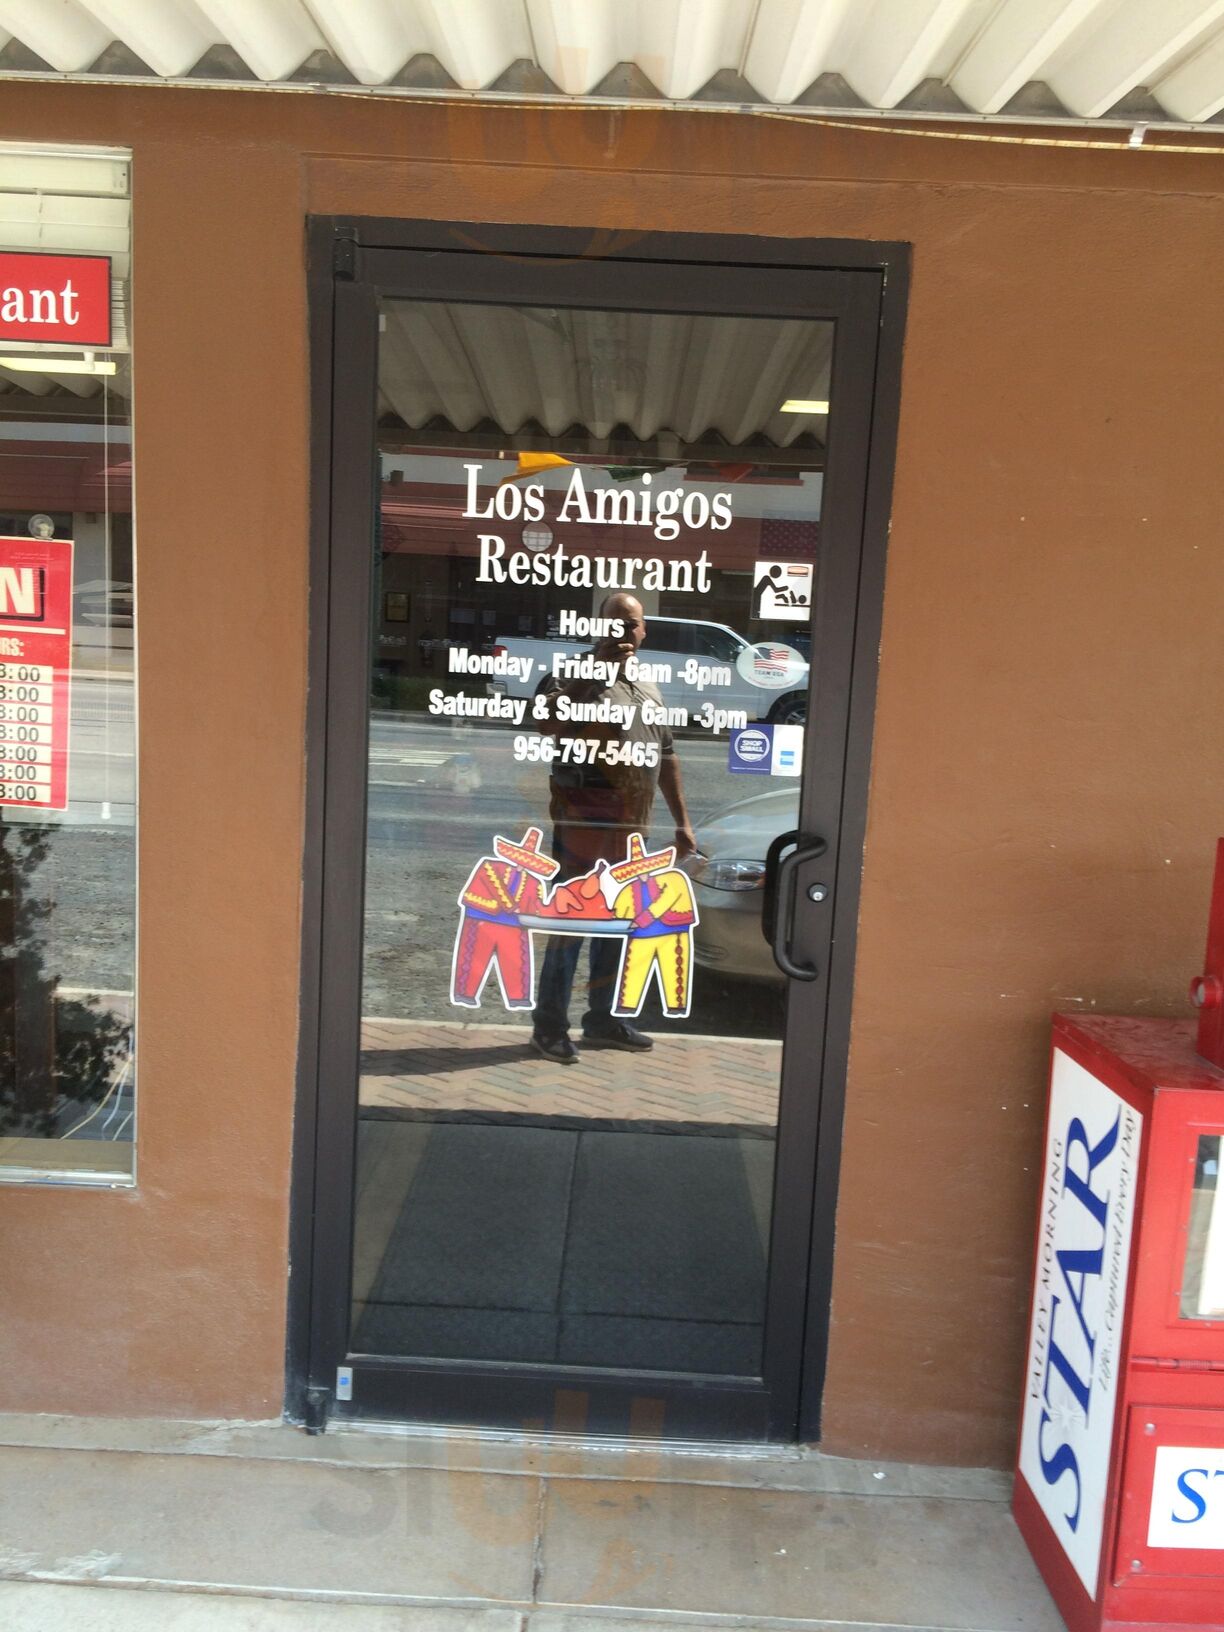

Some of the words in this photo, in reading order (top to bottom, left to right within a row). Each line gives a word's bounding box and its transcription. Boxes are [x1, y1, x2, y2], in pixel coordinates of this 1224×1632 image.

[461, 463, 546, 521] Los
[555, 467, 733, 541] Amigos
[475, 533, 713, 594] Restaurant
[559, 609, 625, 638] Hours
[448, 647, 534, 683] Monday
[551, 652, 620, 687] Friday
[624, 655, 672, 683] 6am
[428, 688, 527, 725] Saturday
[532, 694, 550, 720] &
[555, 695, 636, 730] Sunday
[641, 698, 688, 727] 6am
[513, 735, 659, 768] 956-797-5465
[739, 745, 764, 753] SMALL
[741, 739, 763, 747] SHOP
[1031, 1299, 1048, 1399] VALLEY
[1041, 1137, 1063, 1290] MORNING
[1038, 1103, 1122, 1534] STAR
[1171, 1468, 1224, 1524] S
